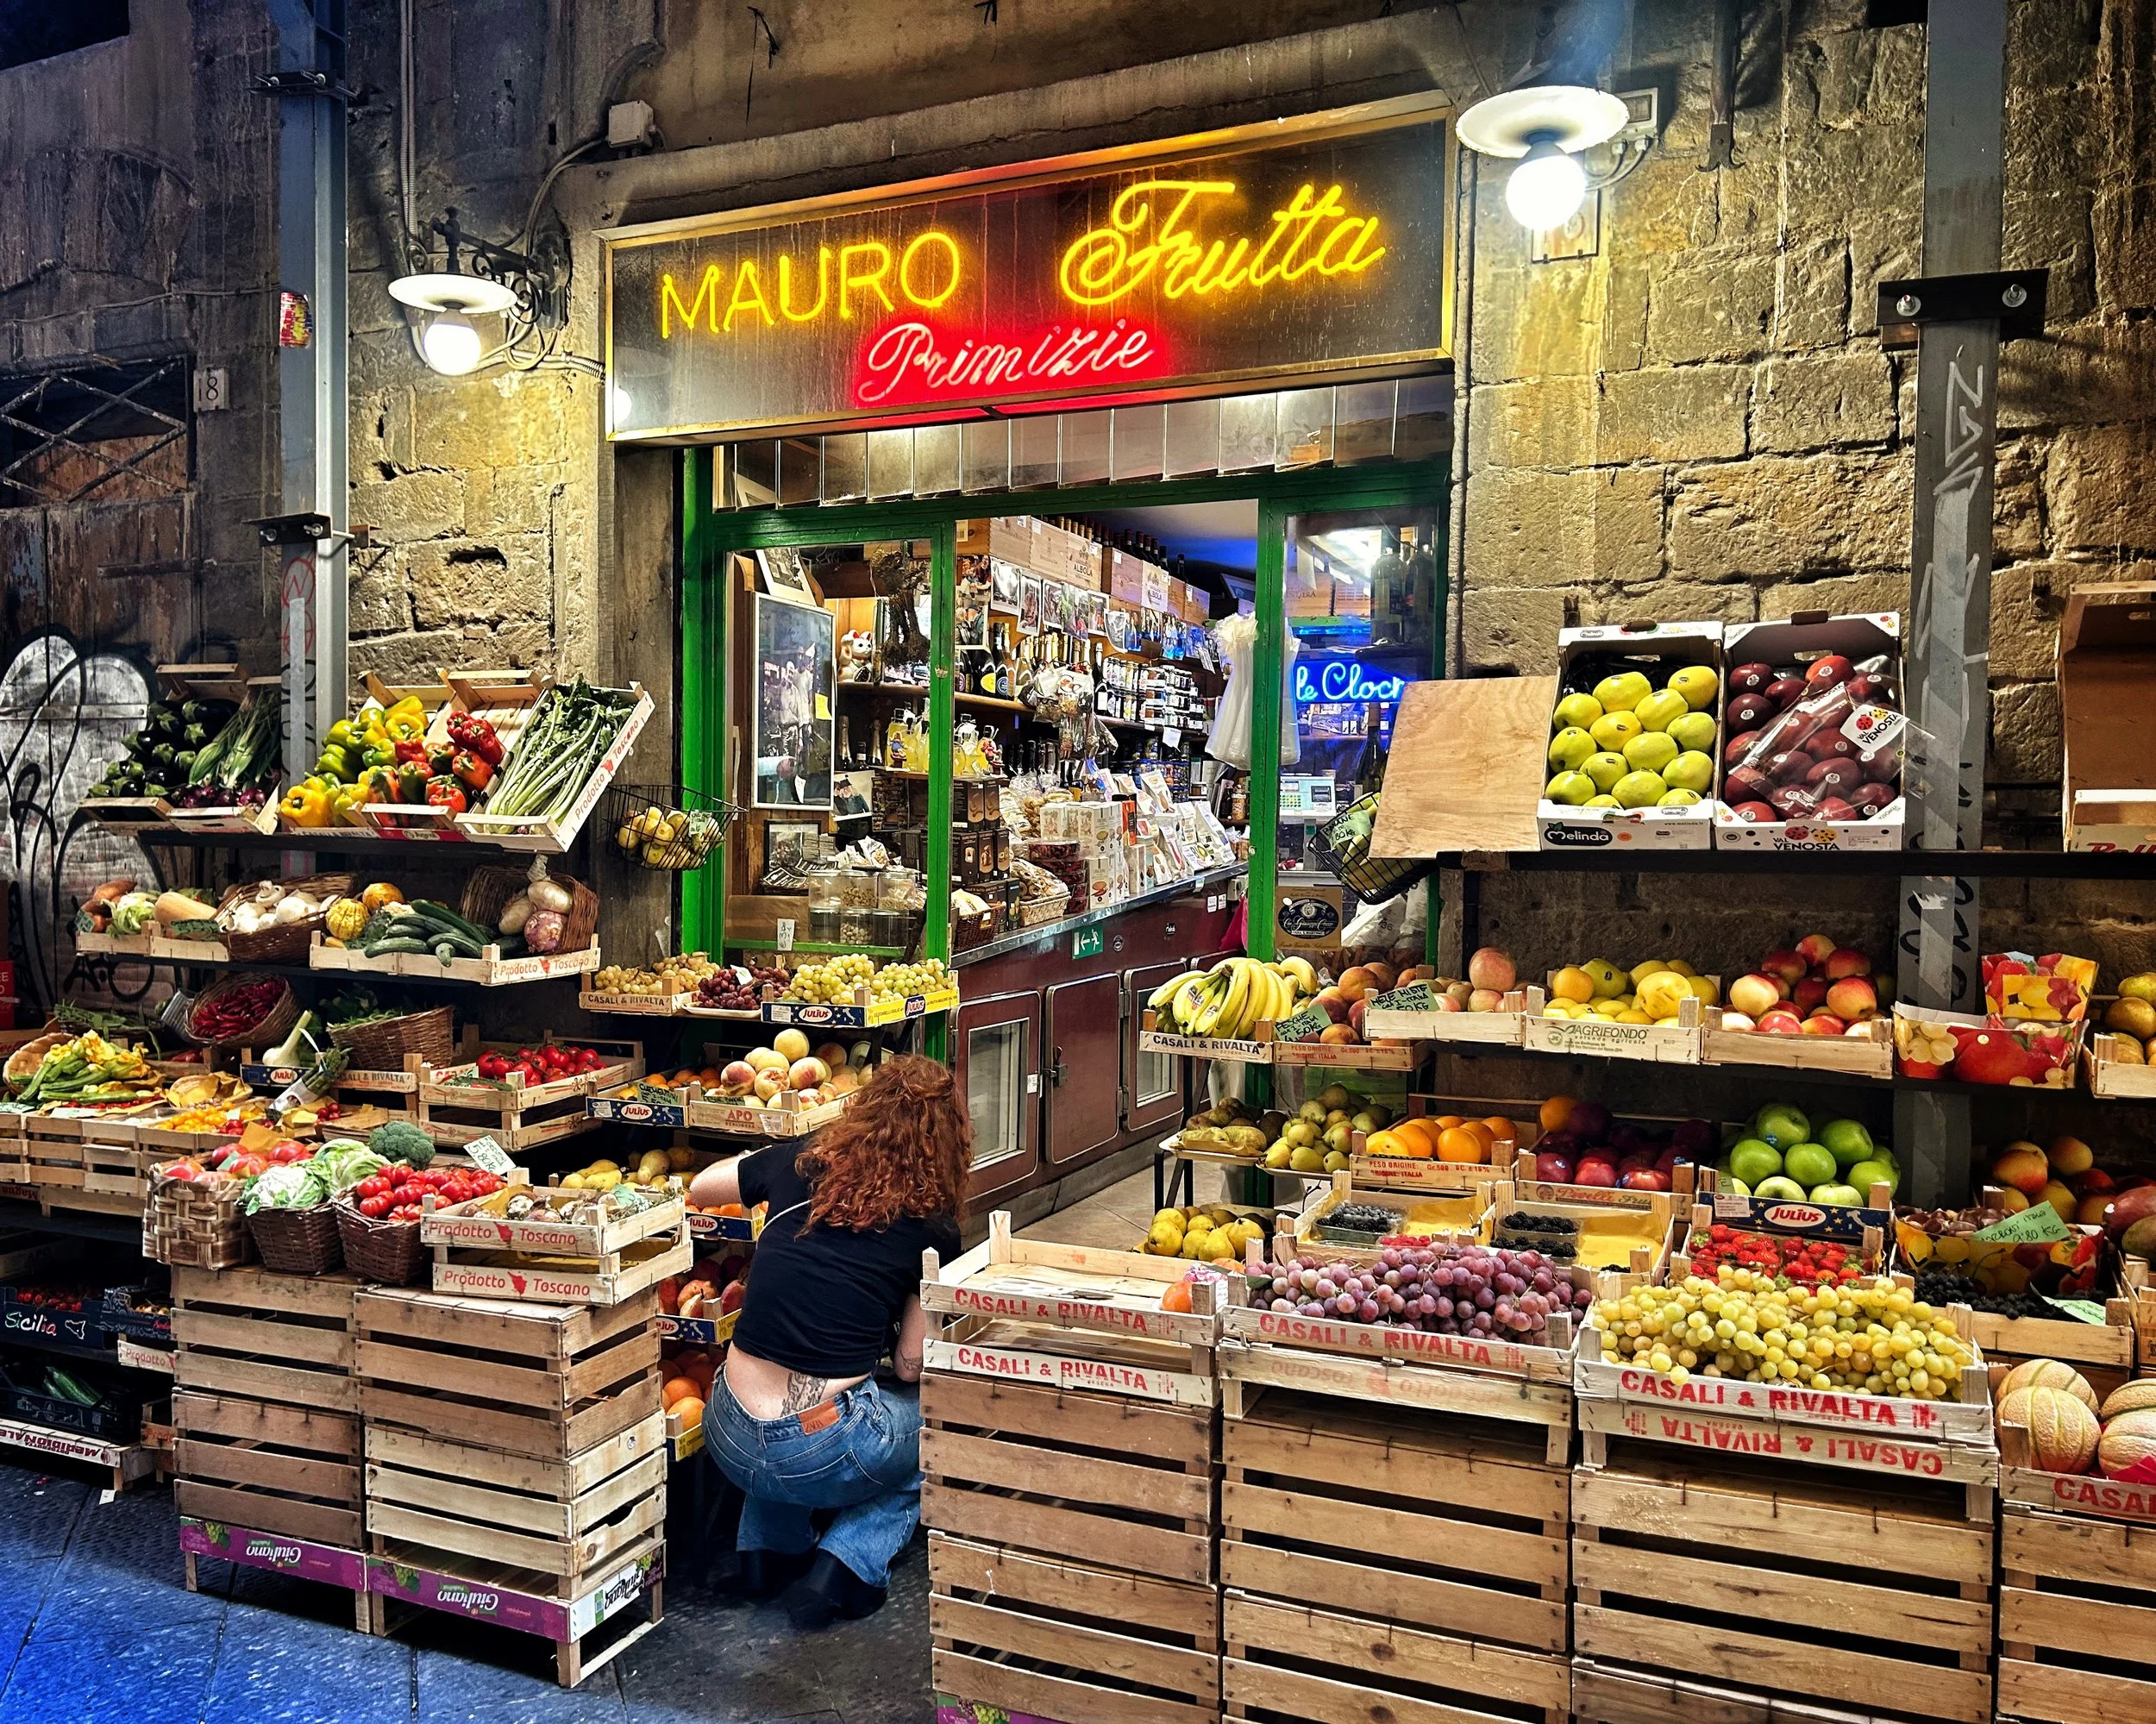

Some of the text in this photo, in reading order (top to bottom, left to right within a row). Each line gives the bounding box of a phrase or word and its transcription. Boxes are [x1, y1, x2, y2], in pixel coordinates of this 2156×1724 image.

[660, 179, 1386, 339] MAURO Frutta
[857, 319, 1155, 401] Primizie
[197, 376, 219, 402] 18
[1073, 563, 1094, 577] ALBOLA
[1295, 665, 1319, 701] le
[1857, 730, 1870, 741] VAL
[1862, 713, 1900, 745] VENOSTA
[574, 719, 641, 820] Prodotto Toscano
[1546, 831, 1609, 843] Melinda
[499, 955, 590, 978] Prodotto Toscano
[587, 994, 618, 1005] CASALI
[630, 995, 665, 1006] RIVALTA
[1370, 991, 1396, 1007] MELE
[803, 1007, 830, 1019] JULIUS
[1574, 1025, 1647, 1040] AGRIFONDO
[1152, 1034, 1261, 1056] CASALI & RIVALTA
[372, 1072, 405, 1084] RIVALTA
[624, 1106, 649, 1117] JULIUS
[726, 1109, 754, 1122] APO
[1388, 1161, 1419, 1170] ORIGINE:
[1771, 1207, 1821, 1223] JULIUS
[429, 1219, 577, 1246] Prodotto Toscano
[444, 1269, 591, 1296] Prodotto Toscano
[955, 1288, 1149, 1333] CASALI & RIVALTA
[4, 1311, 58, 1337] Sicilia
[656, 1322, 676, 1332] IUS
[1259, 1313, 1492, 1366] CASALI & RIVALTA
[125, 1347, 166, 1367] Prodotto
[958, 1347, 1149, 1393] CASALI & RIVALTA
[1620, 1370, 1897, 1427] CASALI & RIVALTA
[147, 1426, 173, 1443] Prodo
[1660, 1414, 1943, 1476] CASALI & RIVALTA
[246, 1545, 302, 1564] Giuliano
[437, 1589, 499, 1612] Giuliano
